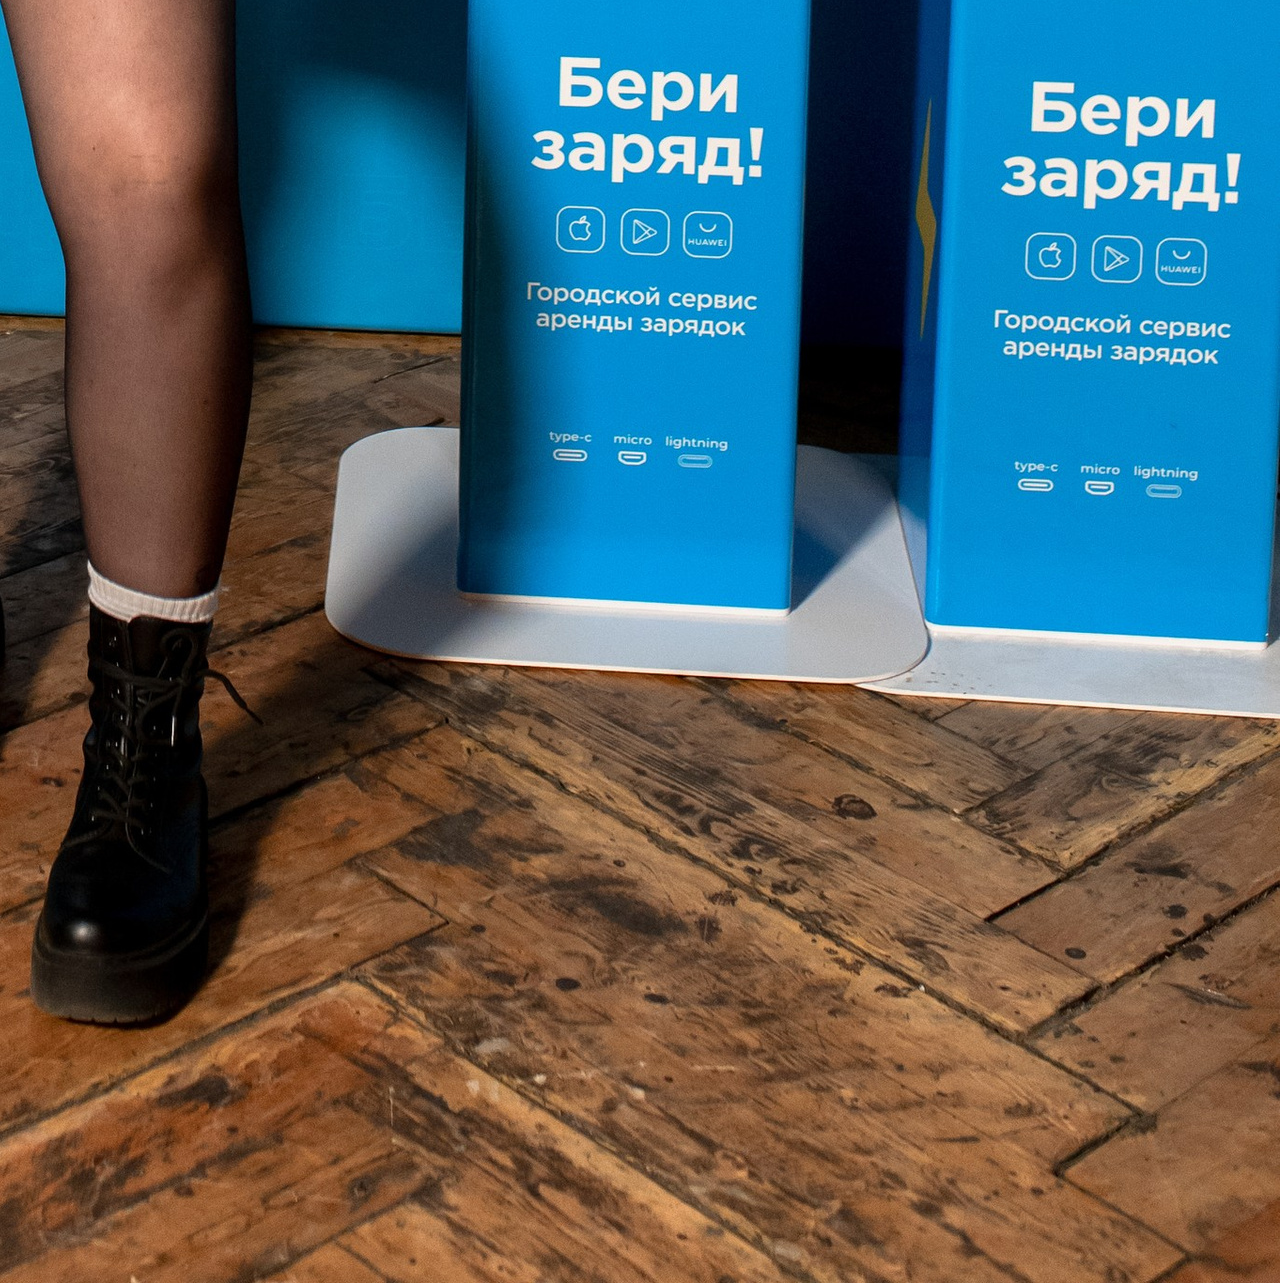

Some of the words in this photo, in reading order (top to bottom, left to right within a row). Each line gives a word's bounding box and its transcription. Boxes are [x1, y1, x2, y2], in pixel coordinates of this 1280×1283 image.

[559, 57, 738, 121] Бери
[1031, 82, 1215, 147] Бери
[531, 128, 763, 185] заряд!
[1002, 153, 1241, 212] заряд!
[687, 237, 728, 247] HUAWEI
[1160, 264, 1202, 274] HUAWEI
[527, 281, 660, 308] Городской
[668, 293, 757, 312] сервис
[536, 313, 633, 333] аренды
[641, 317, 746, 338] зарядок
[994, 309, 1131, 336] Городской
[1139, 320, 1231, 340] сервис
[1003, 341, 1102, 362] аренды
[1110, 346, 1218, 366] зарядок
[549, 431, 592, 444] type-c
[613, 434, 652, 445] micro
[665, 435, 729, 451] lightning
[1014, 461, 1059, 473] type-c
[1080, 463, 1120, 475] micro
[1133, 465, 1199, 482] lightning
